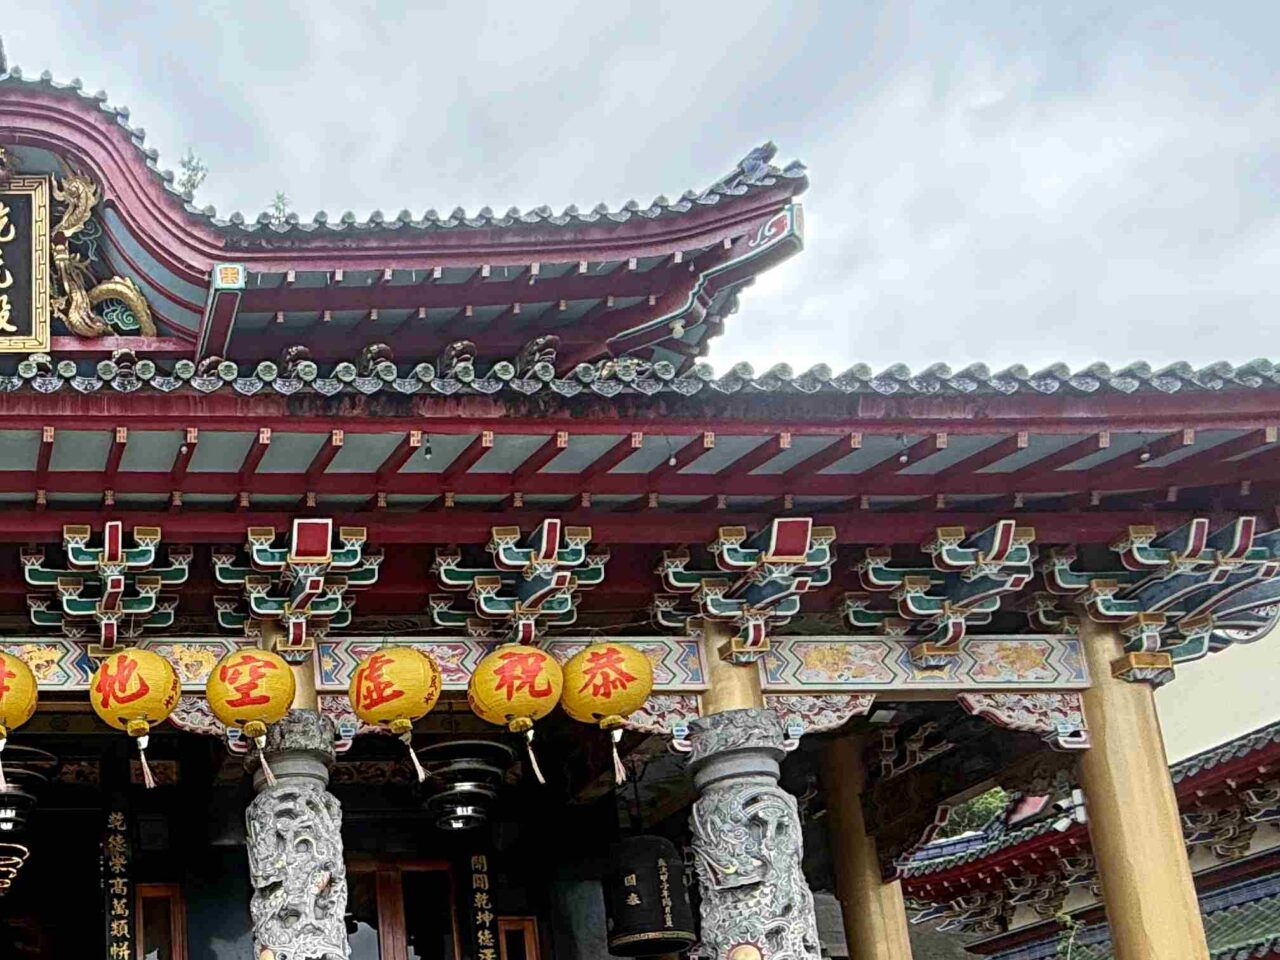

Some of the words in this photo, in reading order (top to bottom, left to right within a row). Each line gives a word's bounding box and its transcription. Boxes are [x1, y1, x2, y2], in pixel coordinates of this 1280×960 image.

[95, 655, 150, 709] 地
[219, 655, 278, 708] 空
[355, 654, 406, 711] 虛
[493, 651, 553, 701] 祝
[577, 647, 638, 699] 恭
